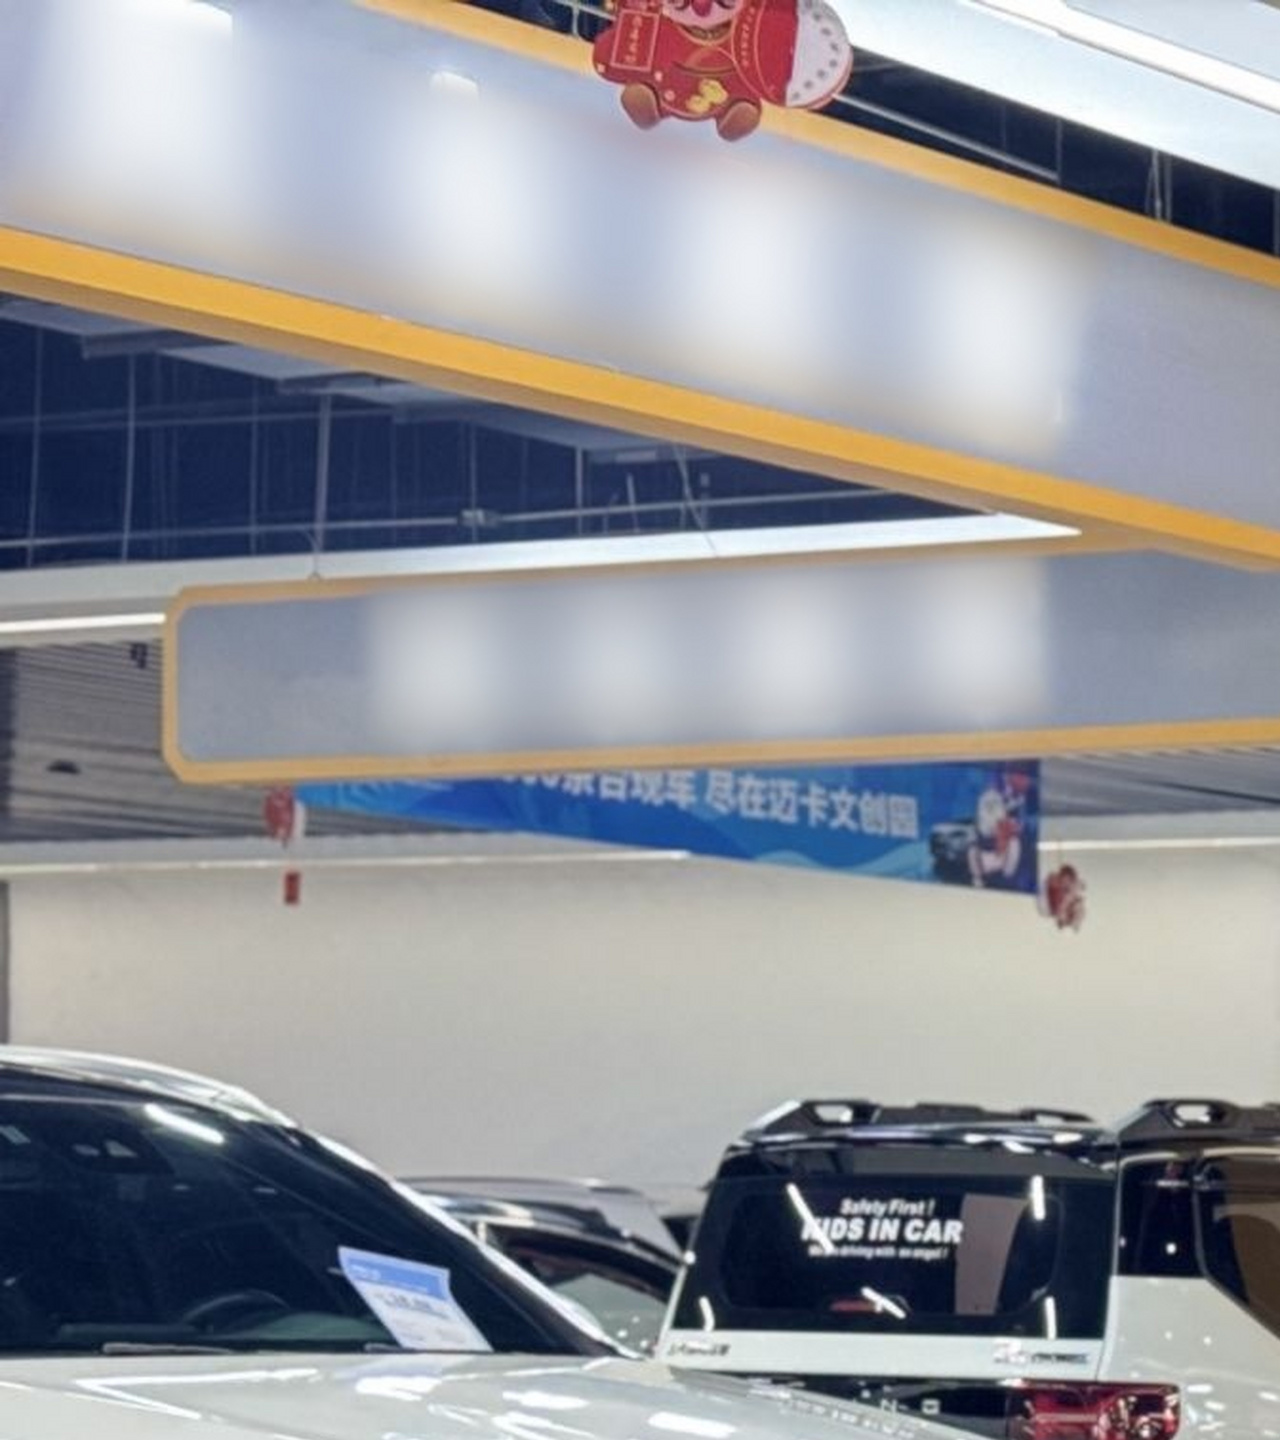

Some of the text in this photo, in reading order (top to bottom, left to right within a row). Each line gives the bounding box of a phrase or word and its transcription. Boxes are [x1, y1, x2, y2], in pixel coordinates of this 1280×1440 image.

[841, 1199, 886, 1218] Safety
[889, 1199, 924, 1216] First
[802, 1217, 964, 1243] KIDS IN CAR
